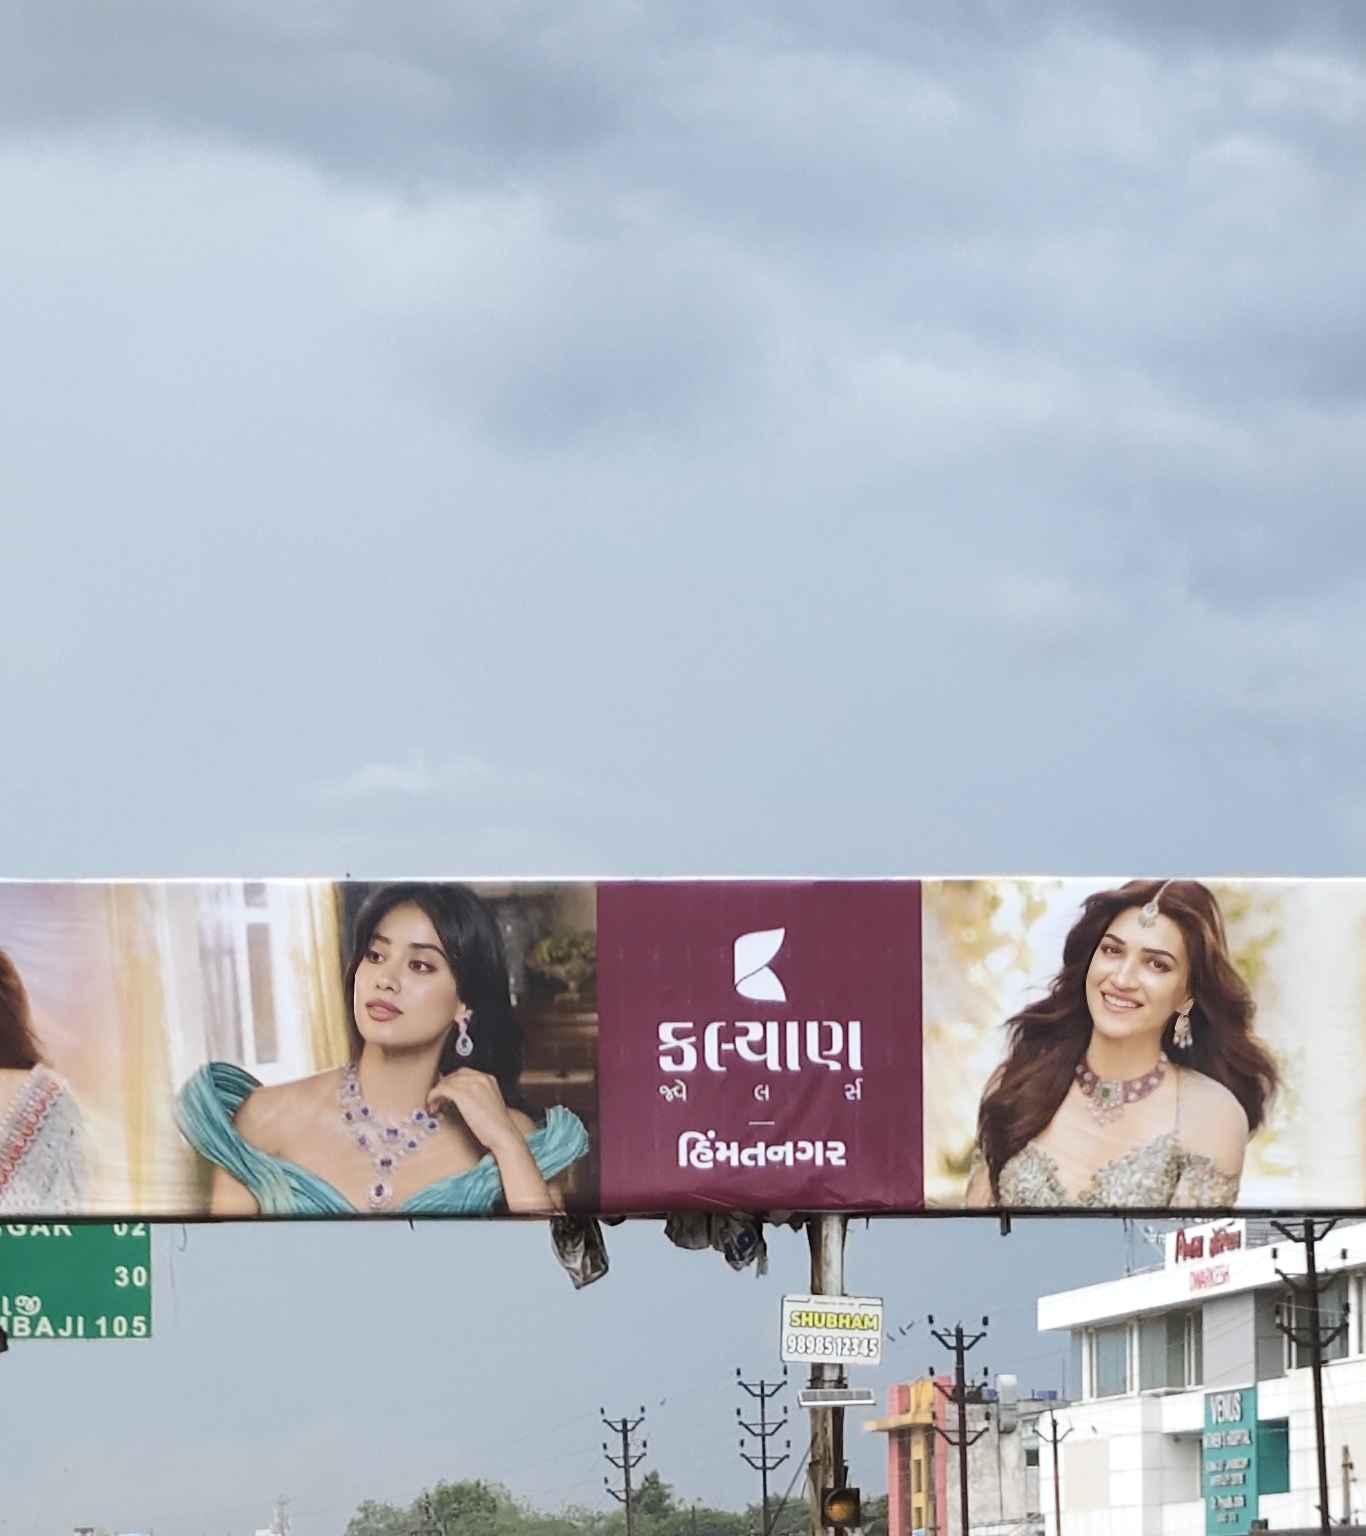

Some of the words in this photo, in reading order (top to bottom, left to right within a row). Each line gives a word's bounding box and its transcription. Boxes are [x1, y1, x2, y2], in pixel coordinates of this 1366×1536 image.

[657, 1020, 864, 1072] કલ્યાણ
[678, 1130, 846, 1168] હિંમતનગર
[114, 1266, 148, 1287] 30
[95, 1316, 148, 1337] 105
[789, 1310, 879, 1331] SHUBHAM
